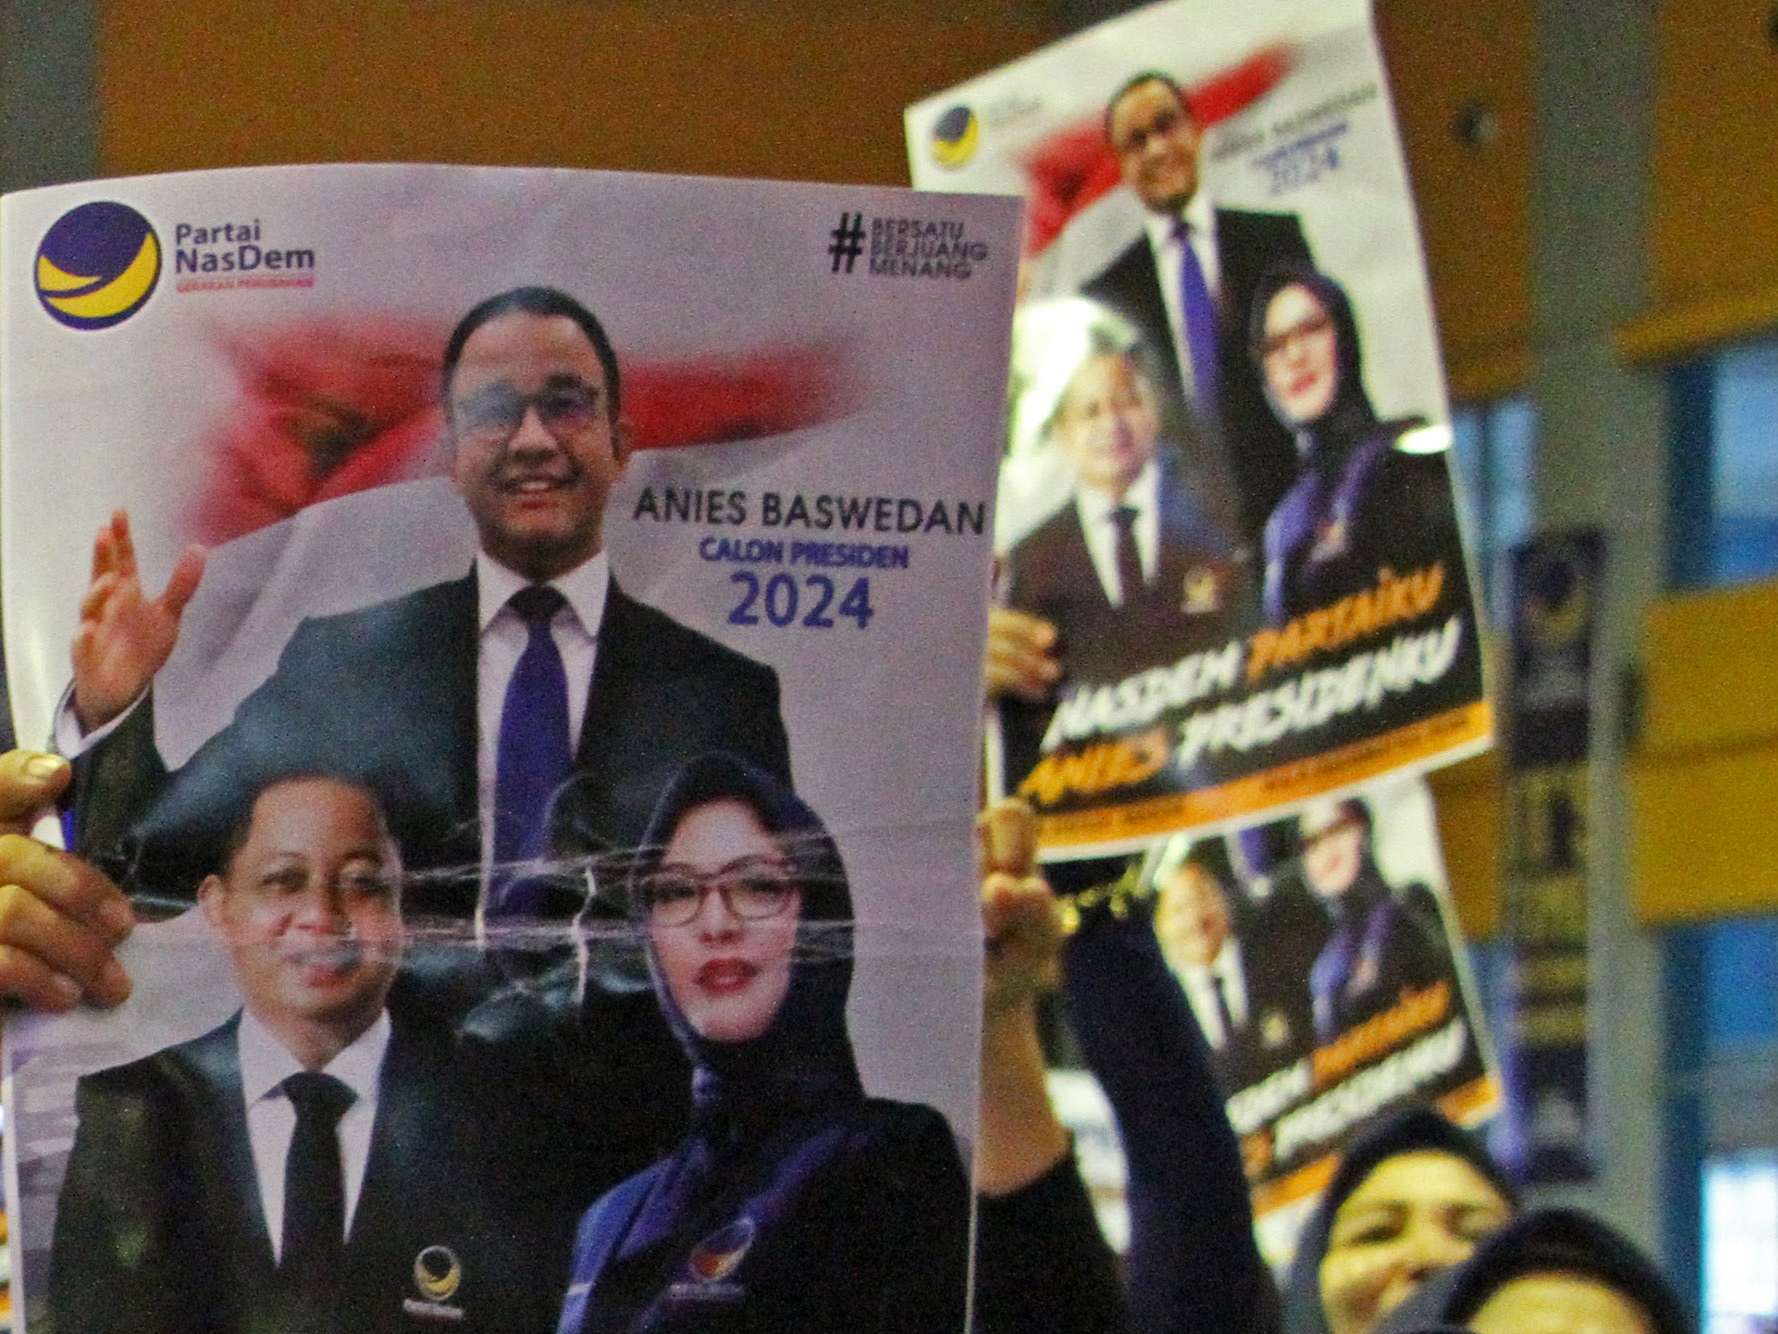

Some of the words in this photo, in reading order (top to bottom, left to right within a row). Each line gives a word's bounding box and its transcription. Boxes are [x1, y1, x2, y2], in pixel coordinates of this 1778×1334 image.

[175, 217, 261, 246] Partai
[872, 217, 965, 241] BERSATU
[175, 244, 316, 274] NasDem
[871, 236, 989, 262] BERJUANG
[869, 257, 972, 280] MENANG
[631, 486, 748, 527] ANIES
[761, 491, 987, 536] BASWEDAN
[698, 535, 785, 564] CALON
[789, 540, 910, 570] PRESIDEN
[726, 569, 874, 630] 2024
